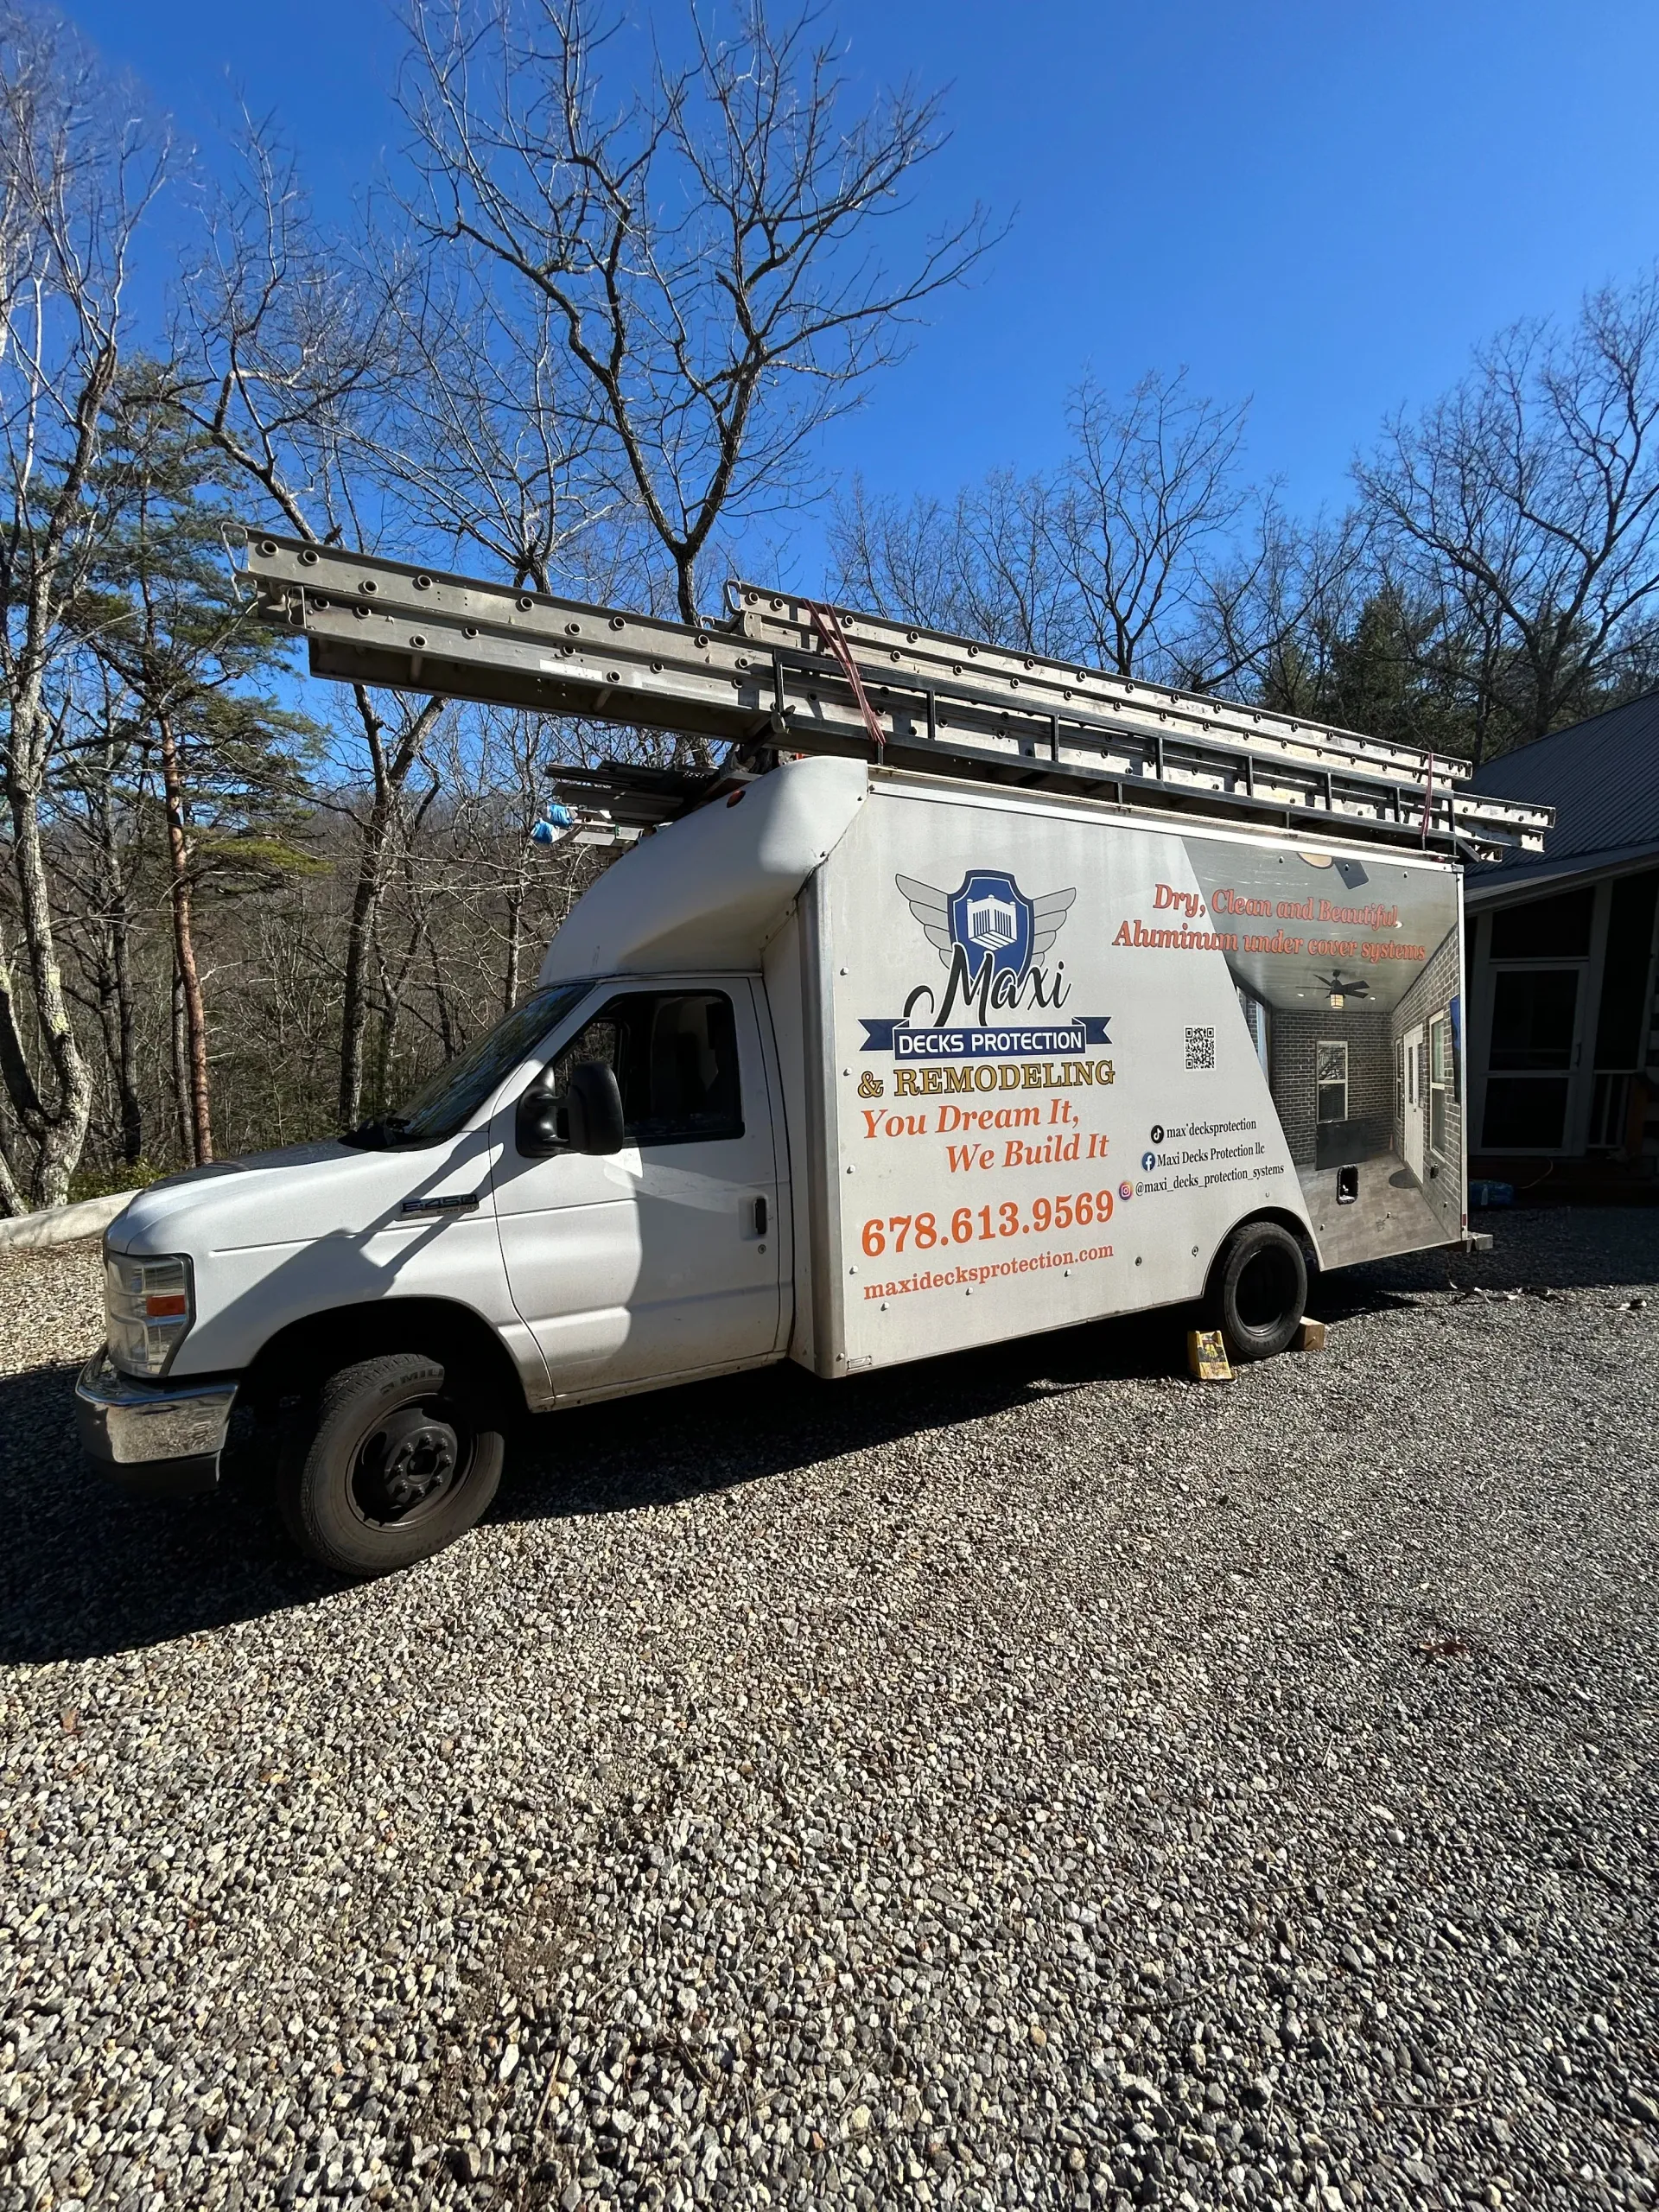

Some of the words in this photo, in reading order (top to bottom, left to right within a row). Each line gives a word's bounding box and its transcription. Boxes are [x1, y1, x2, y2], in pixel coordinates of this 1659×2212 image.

[1153, 884, 1206, 918] Dry,
[1211, 888, 1272, 918] Clean
[1276, 897, 1314, 921] and
[1318, 899, 1398, 931] Beautiful
[1111, 920, 1238, 951] Aluminum
[1243, 929, 1304, 955] under
[1307, 938, 1357, 957] cover
[1361, 940, 1426, 963] systems
[903, 942, 1071, 1027] Maxi
[899, 1033, 964, 1054] DECKS
[971, 1031, 1082, 1052] PROTECTION
[857, 1071, 884, 1098] &
[893, 1060, 1116, 1096] REMODELING
[861, 1109, 926, 1139] You
[935, 1104, 1041, 1134] Dream
[1046, 1098, 1080, 1129] It,
[945, 1143, 995, 1173] We
[1001, 1133, 1081, 1167] Build
[1086, 1133, 1110, 1159] It
[1157, 1151, 1180, 1166] Maxi
[1182, 1148, 1209, 1164] Decks
[1210, 1144, 1254, 1160] Protection
[1135, 1164, 1285, 1196] @maxi_decks_protection_systems
[861, 1189, 1115, 1257] 678.613.9569
[863, 1244, 1115, 1300] maxidecksprotection.com
